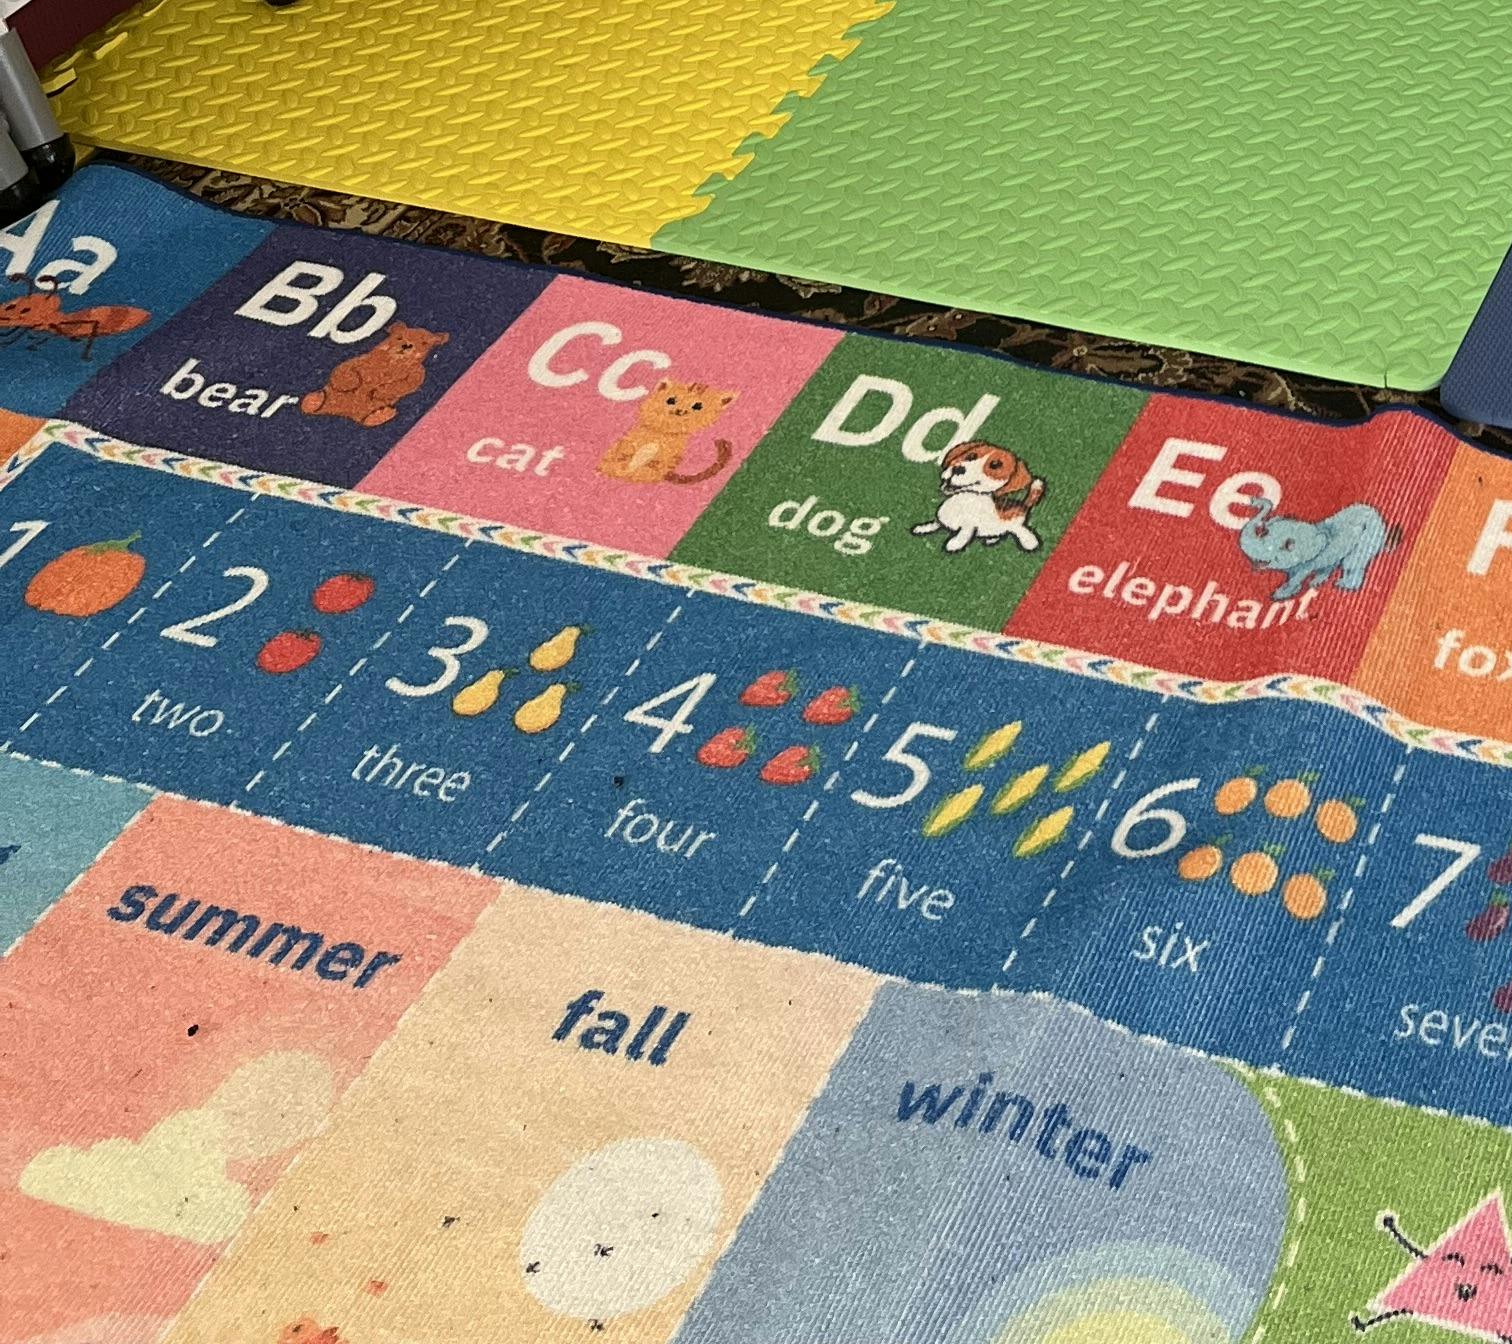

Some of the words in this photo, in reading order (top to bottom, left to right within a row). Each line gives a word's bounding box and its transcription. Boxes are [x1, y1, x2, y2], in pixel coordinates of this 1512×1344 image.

[234, 261, 397, 344] Bb
[159, 358, 298, 419] bear
[527, 321, 672, 402] Cc
[466, 433, 565, 476] cat
[811, 374, 1000, 466] Dd
[1127, 437, 1283, 531] Ee
[768, 494, 889, 557] dog
[160, 566, 270, 648] 2
[1068, 560, 1319, 631] elephant
[384, 616, 488, 697] 3
[131, 689, 225, 737] two
[623, 673, 716, 753] 4
[351, 741, 471, 803] three
[851, 722, 958, 809] 5
[604, 798, 716, 860] four
[1109, 778, 1201, 858] 6
[856, 858, 955, 921] five
[1391, 834, 1481, 929] 7
[107, 883, 403, 989] summer
[1132, 921, 1211, 972] six
[551, 989, 691, 1067] fall
[897, 1071, 1152, 1191] winter
